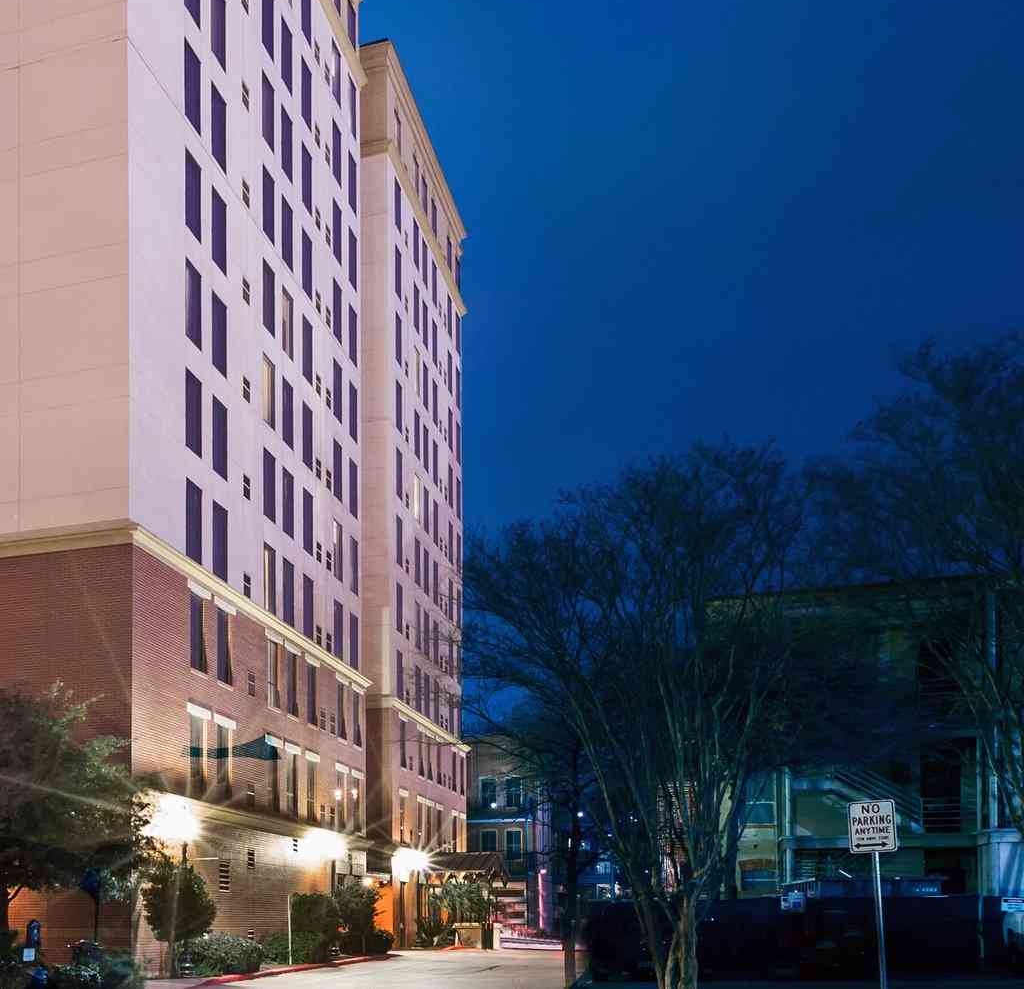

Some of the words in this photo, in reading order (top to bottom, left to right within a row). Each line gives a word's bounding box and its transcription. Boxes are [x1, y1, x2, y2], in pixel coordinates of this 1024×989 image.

[861, 803, 880, 814] NO
[852, 814, 892, 827] PARKING
[855, 826, 892, 835] ANYTIME
